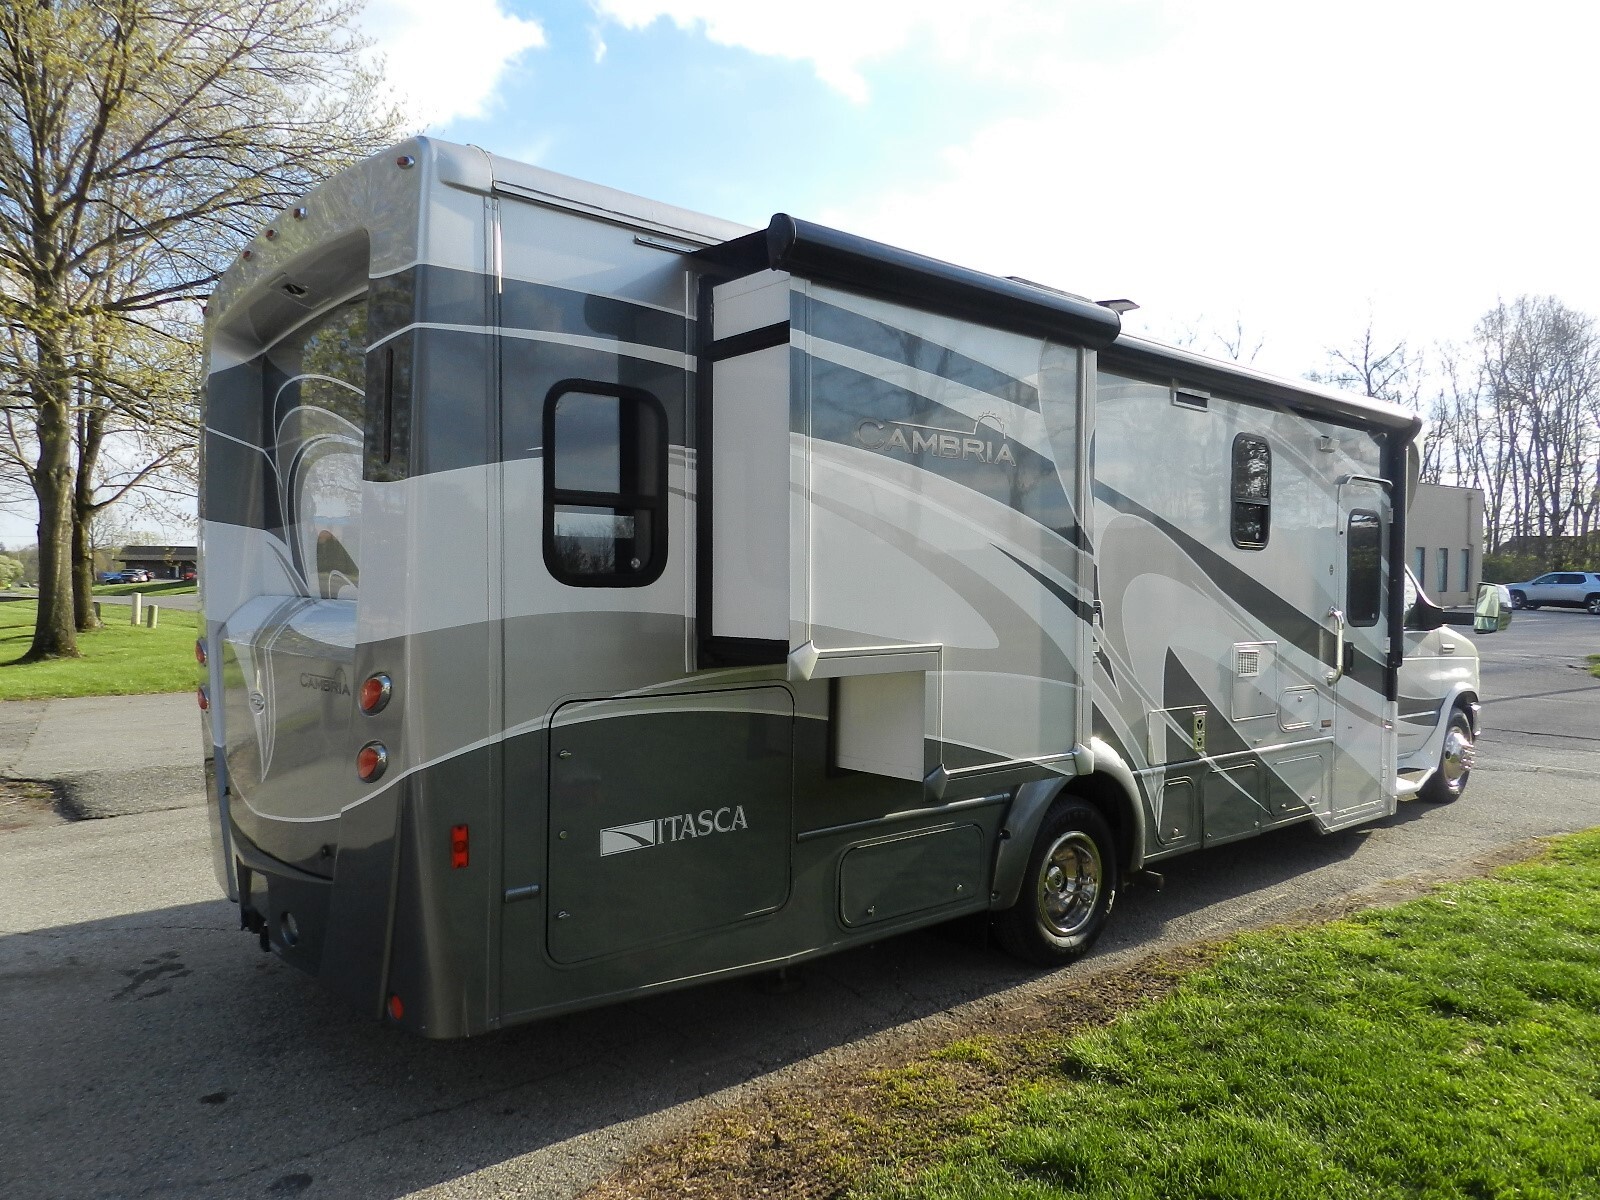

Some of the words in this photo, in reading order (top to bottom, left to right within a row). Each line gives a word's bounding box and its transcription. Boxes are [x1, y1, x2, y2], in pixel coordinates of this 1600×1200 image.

[855, 416, 1017, 467] CAMBRIA
[300, 672, 351, 696] CAMBRIA
[657, 805, 749, 845] ITASCA
